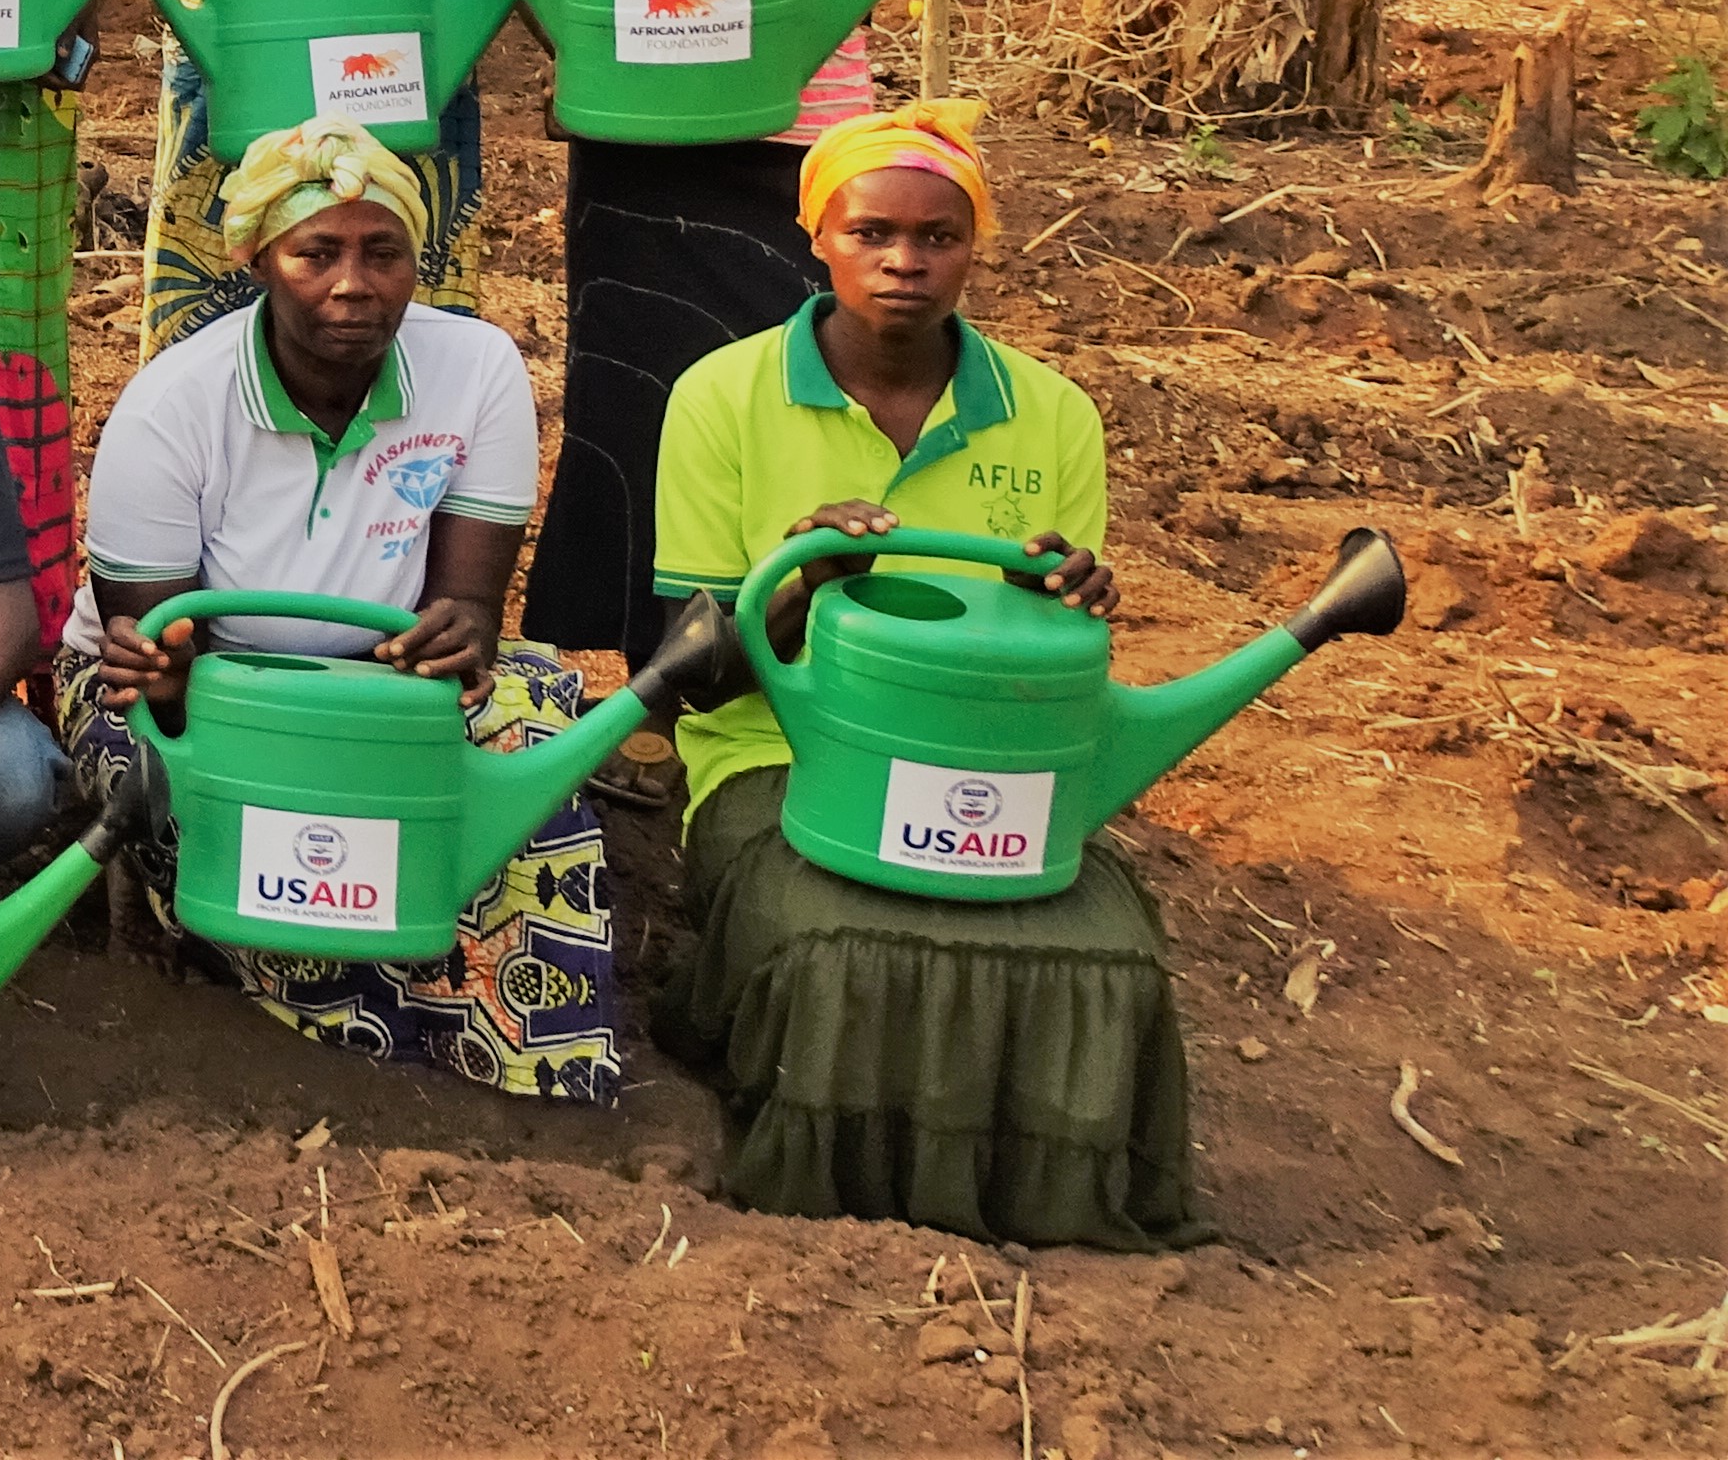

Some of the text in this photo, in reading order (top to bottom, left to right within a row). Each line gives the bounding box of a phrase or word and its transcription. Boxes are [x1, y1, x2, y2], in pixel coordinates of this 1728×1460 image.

[629, 20, 744, 36] AFRICAN WILDLIFE
[646, 37, 729, 50] FOUNDATION
[329, 81, 421, 100] AFRICAN WILDLIFE
[345, 96, 413, 113] FOUNDATION
[363, 433, 468, 486] WASHINGTON
[968, 462, 1042, 494] AFLB
[365, 515, 420, 539] PRIX
[902, 822, 1027, 858] USAID
[257, 873, 378, 910] USAID
[256, 902, 379, 923] FROM THE AMERICAN PEOPLE
